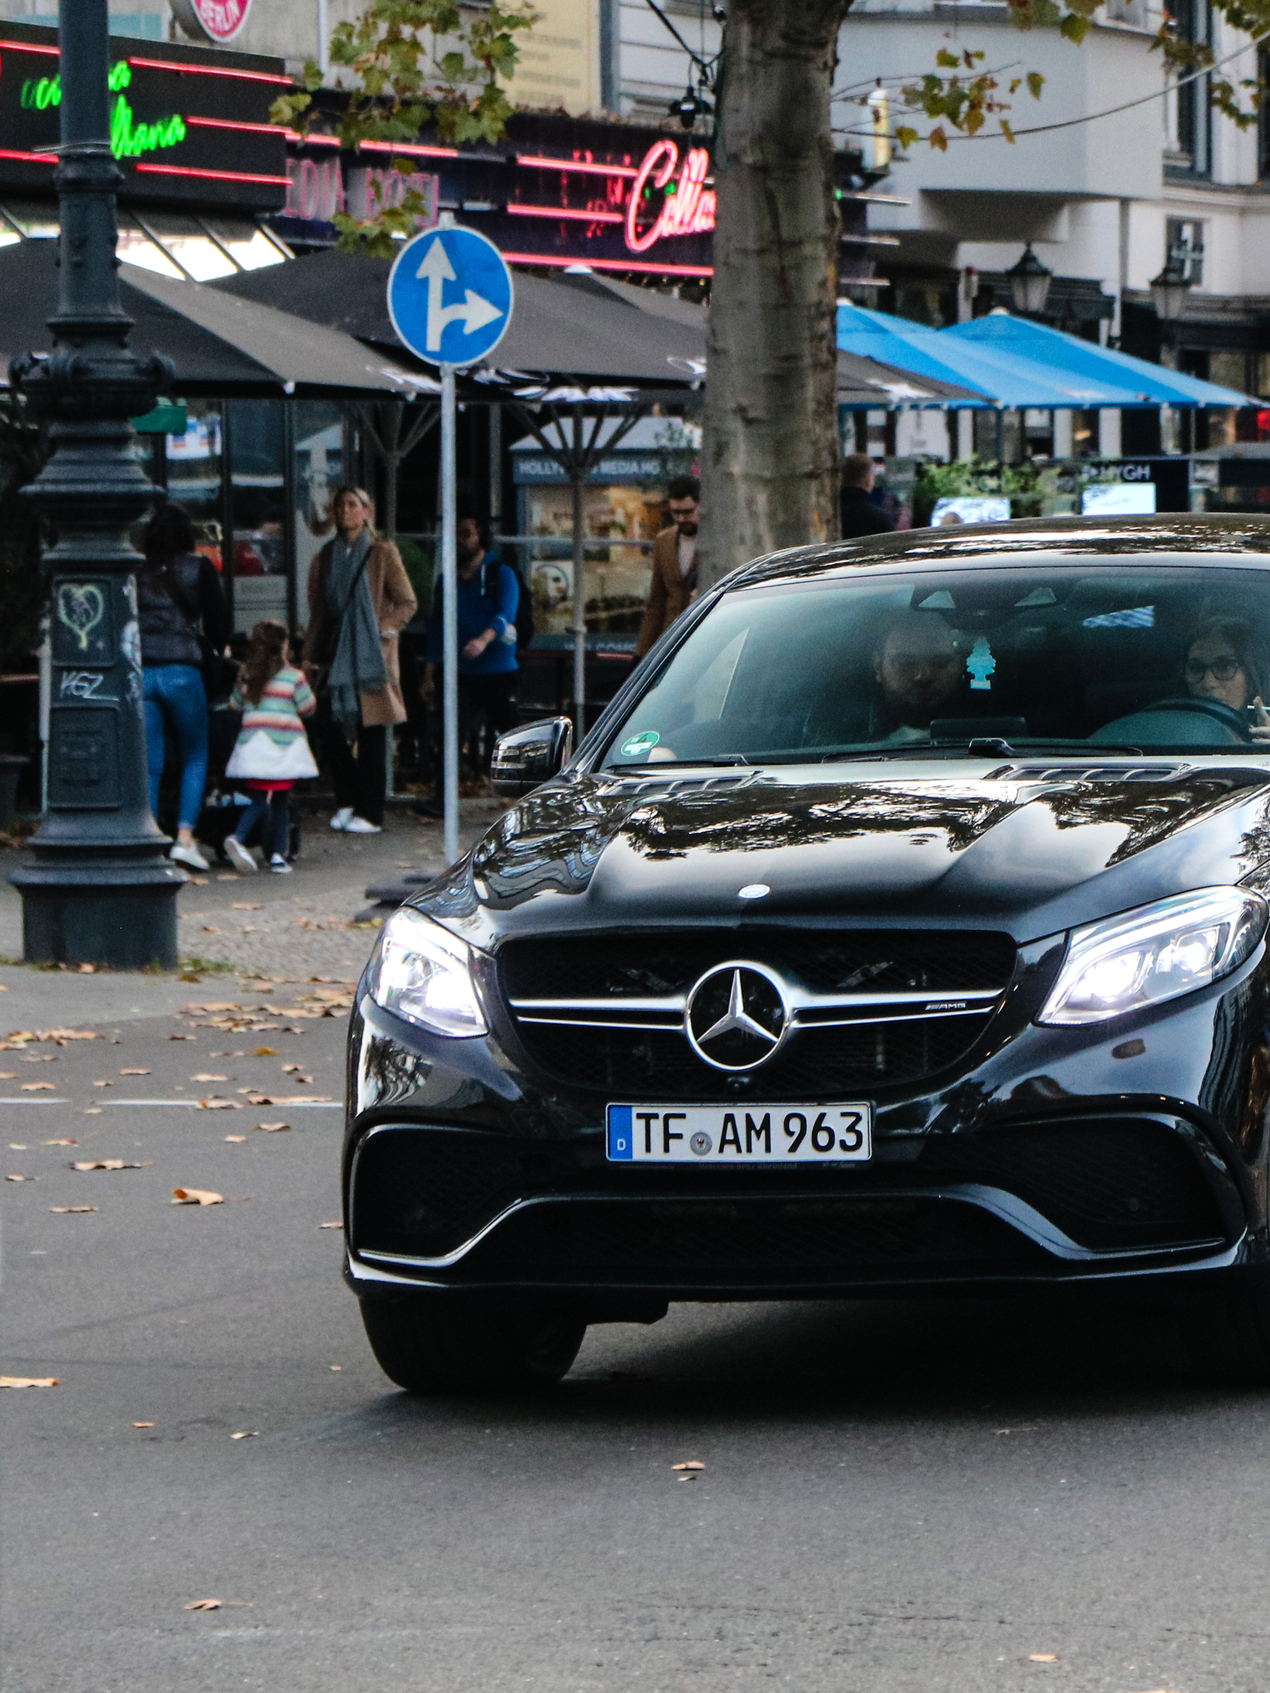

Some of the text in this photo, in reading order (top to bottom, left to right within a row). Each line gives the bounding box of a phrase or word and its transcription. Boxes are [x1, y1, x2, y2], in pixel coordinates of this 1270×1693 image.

[285, 157, 346, 220] EDIA
[616, 1138, 627, 1151] D
[636, 1111, 864, 1154] TF AM 963
